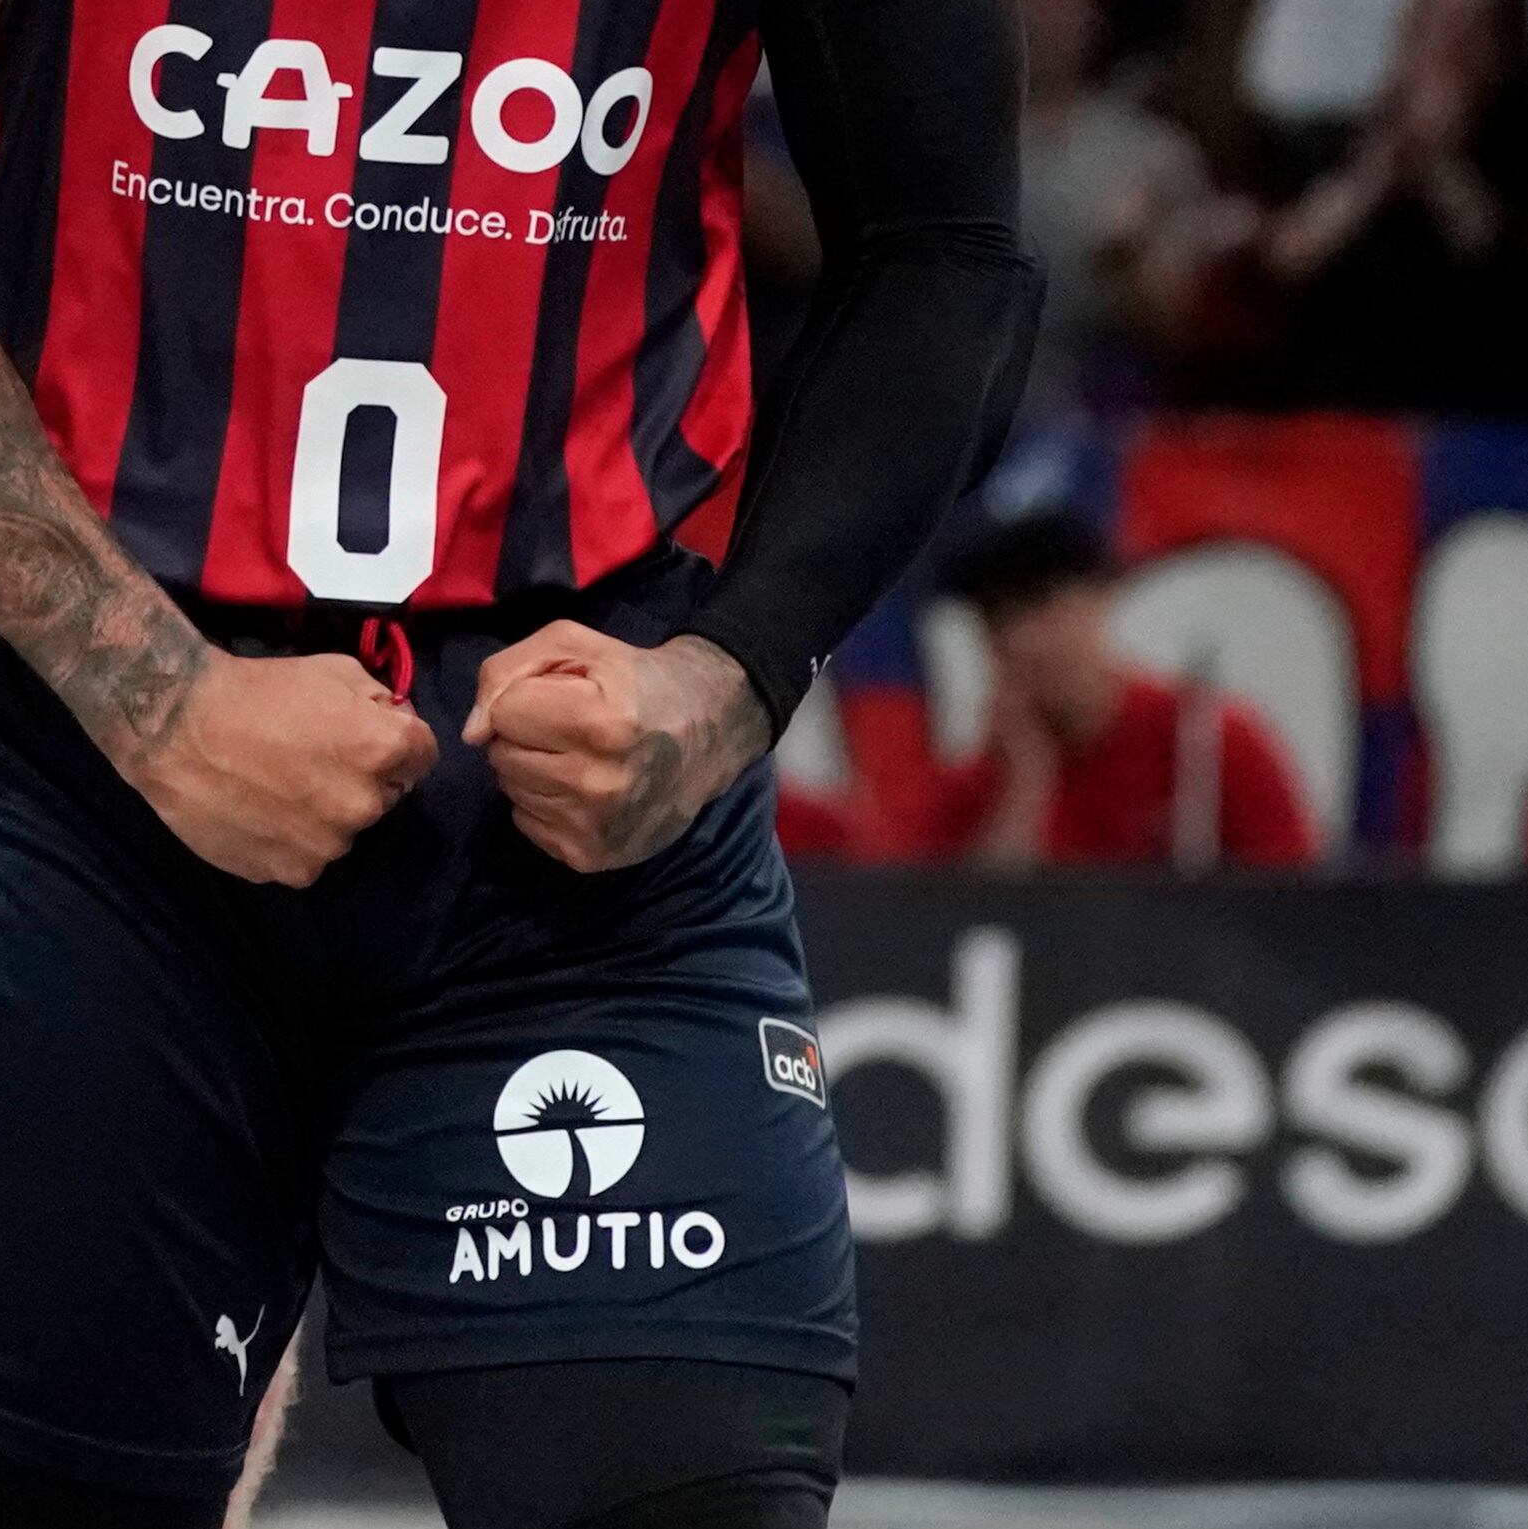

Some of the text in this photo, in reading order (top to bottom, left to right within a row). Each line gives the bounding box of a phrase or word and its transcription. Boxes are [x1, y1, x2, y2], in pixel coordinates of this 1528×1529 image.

[128, 23, 653, 176] CAZOO
[111, 159, 315, 226] Encuentra.
[324, 191, 513, 240] Conduce.
[286, 357, 448, 604] 0
[774, 1053, 817, 1091] acb
[445, 1198, 529, 1222] GRUPO
[449, 1210, 725, 1284] AMUTIO
